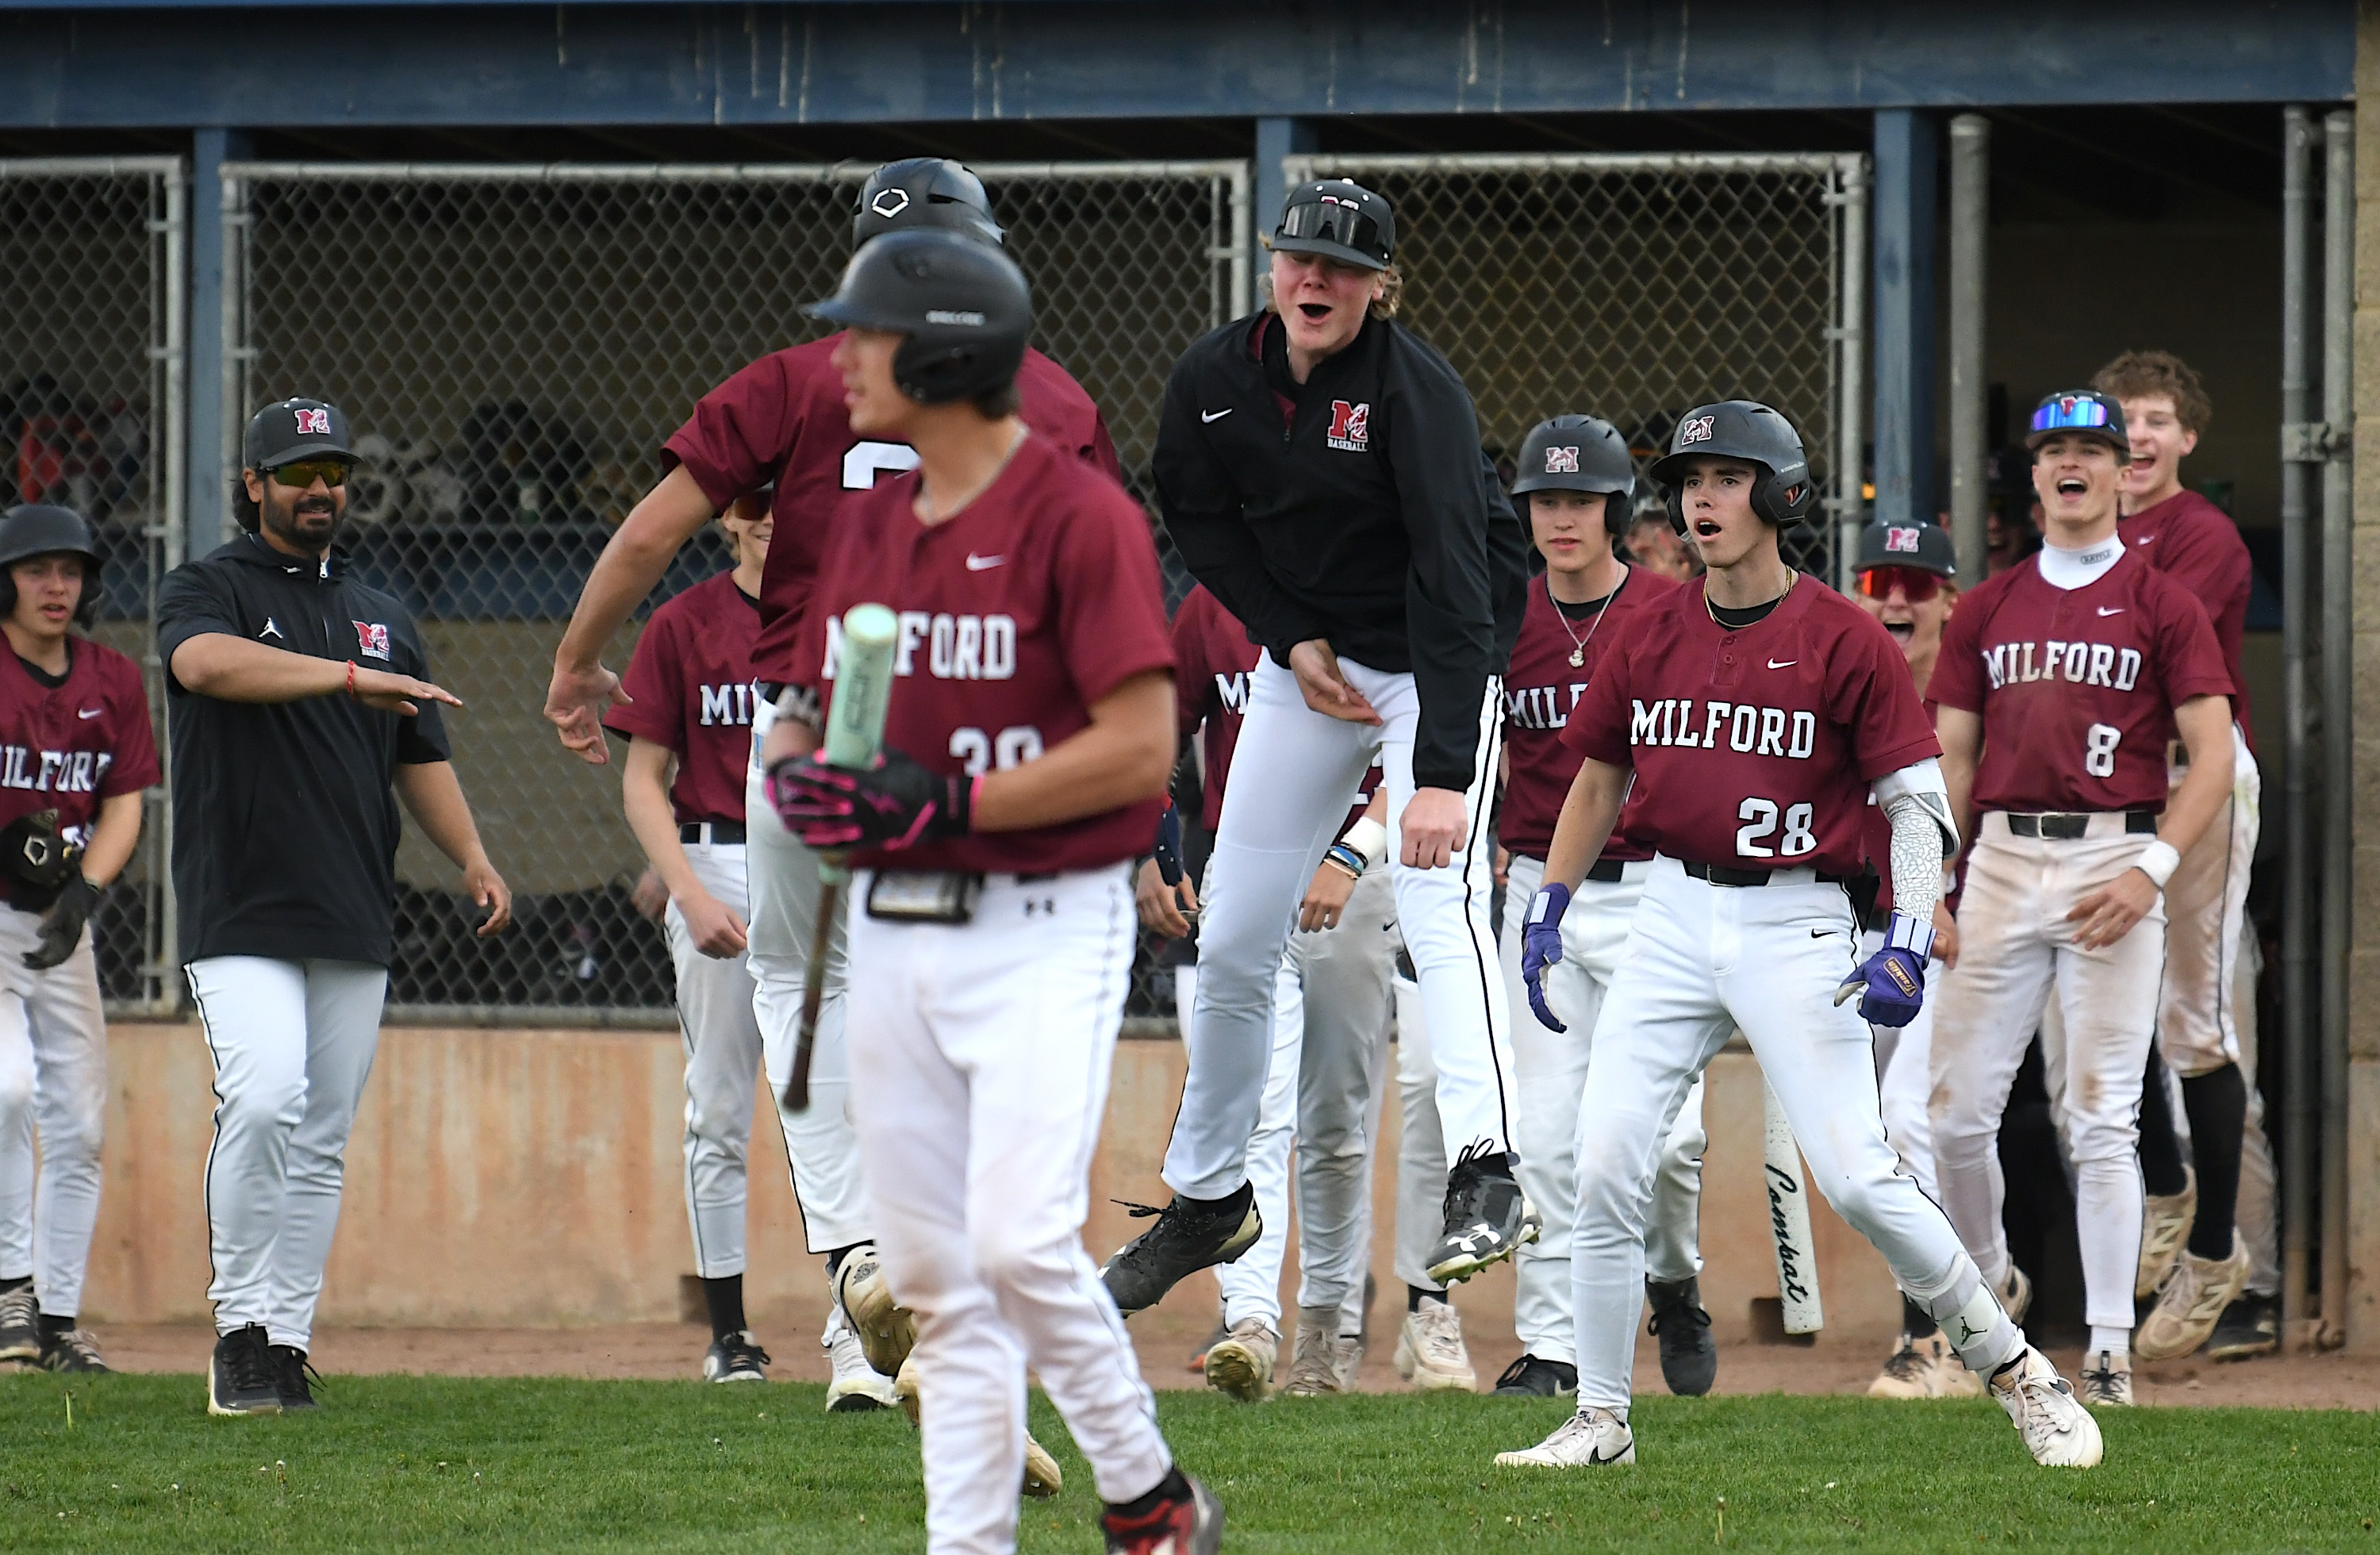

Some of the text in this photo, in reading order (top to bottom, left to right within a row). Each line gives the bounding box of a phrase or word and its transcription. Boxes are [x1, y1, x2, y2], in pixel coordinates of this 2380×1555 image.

[1327, 438, 1368, 452] BASEBALL
[1982, 641, 2141, 692] MILFORD
[1630, 699, 1815, 758] MILFORD
[2086, 723, 2122, 778] 8
[1736, 797, 1818, 858] 28
[1764, 1162, 1809, 1304] Combat
